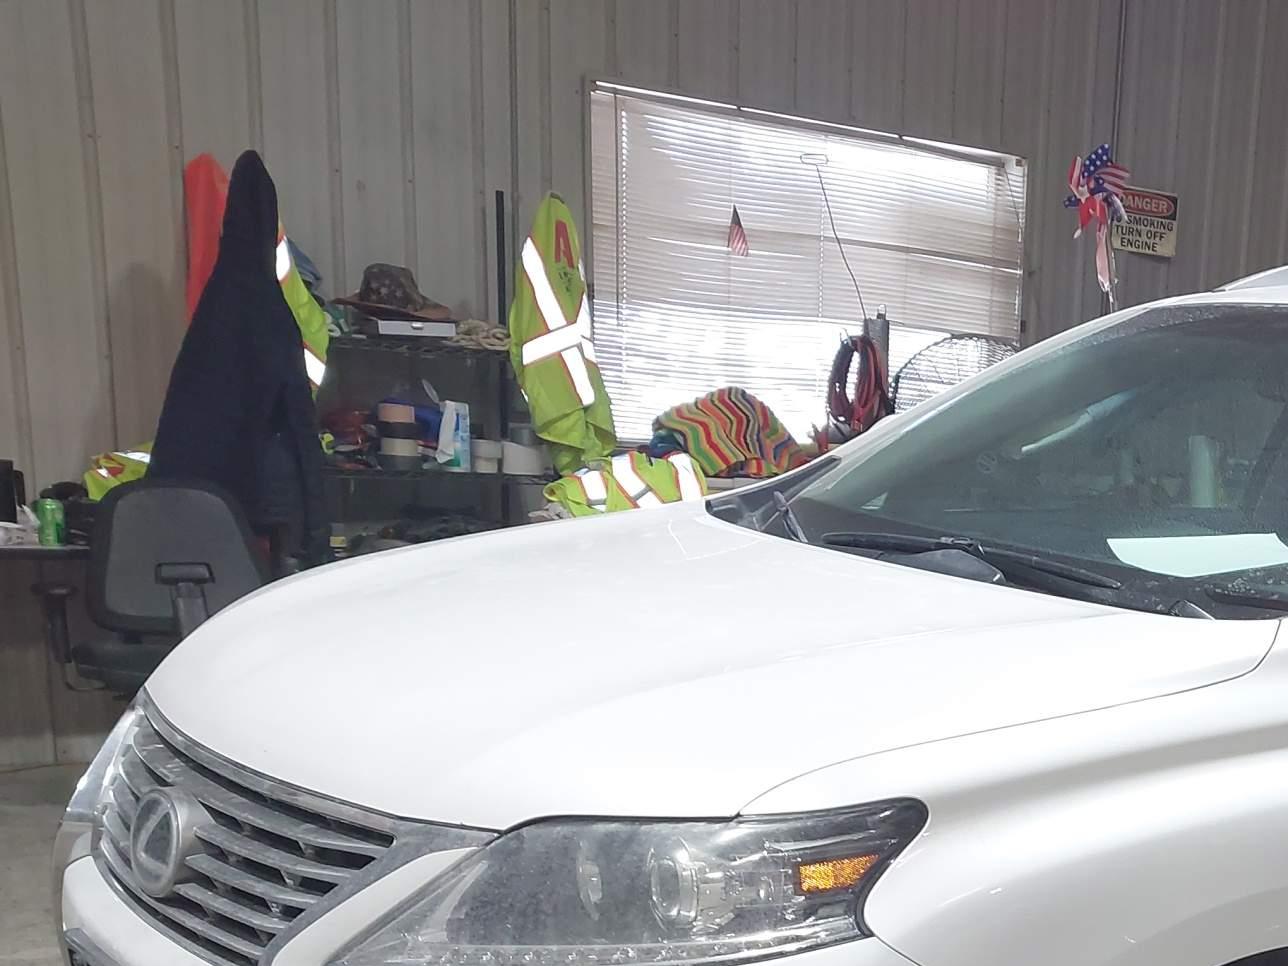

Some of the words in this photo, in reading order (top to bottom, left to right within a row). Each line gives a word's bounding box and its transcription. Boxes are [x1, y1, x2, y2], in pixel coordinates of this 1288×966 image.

[1126, 215, 1174, 232] SMOKING
[1115, 224, 1142, 238] TURN
[1146, 229, 1167, 241] OFF
[1120, 236, 1159, 252] ENGINE
